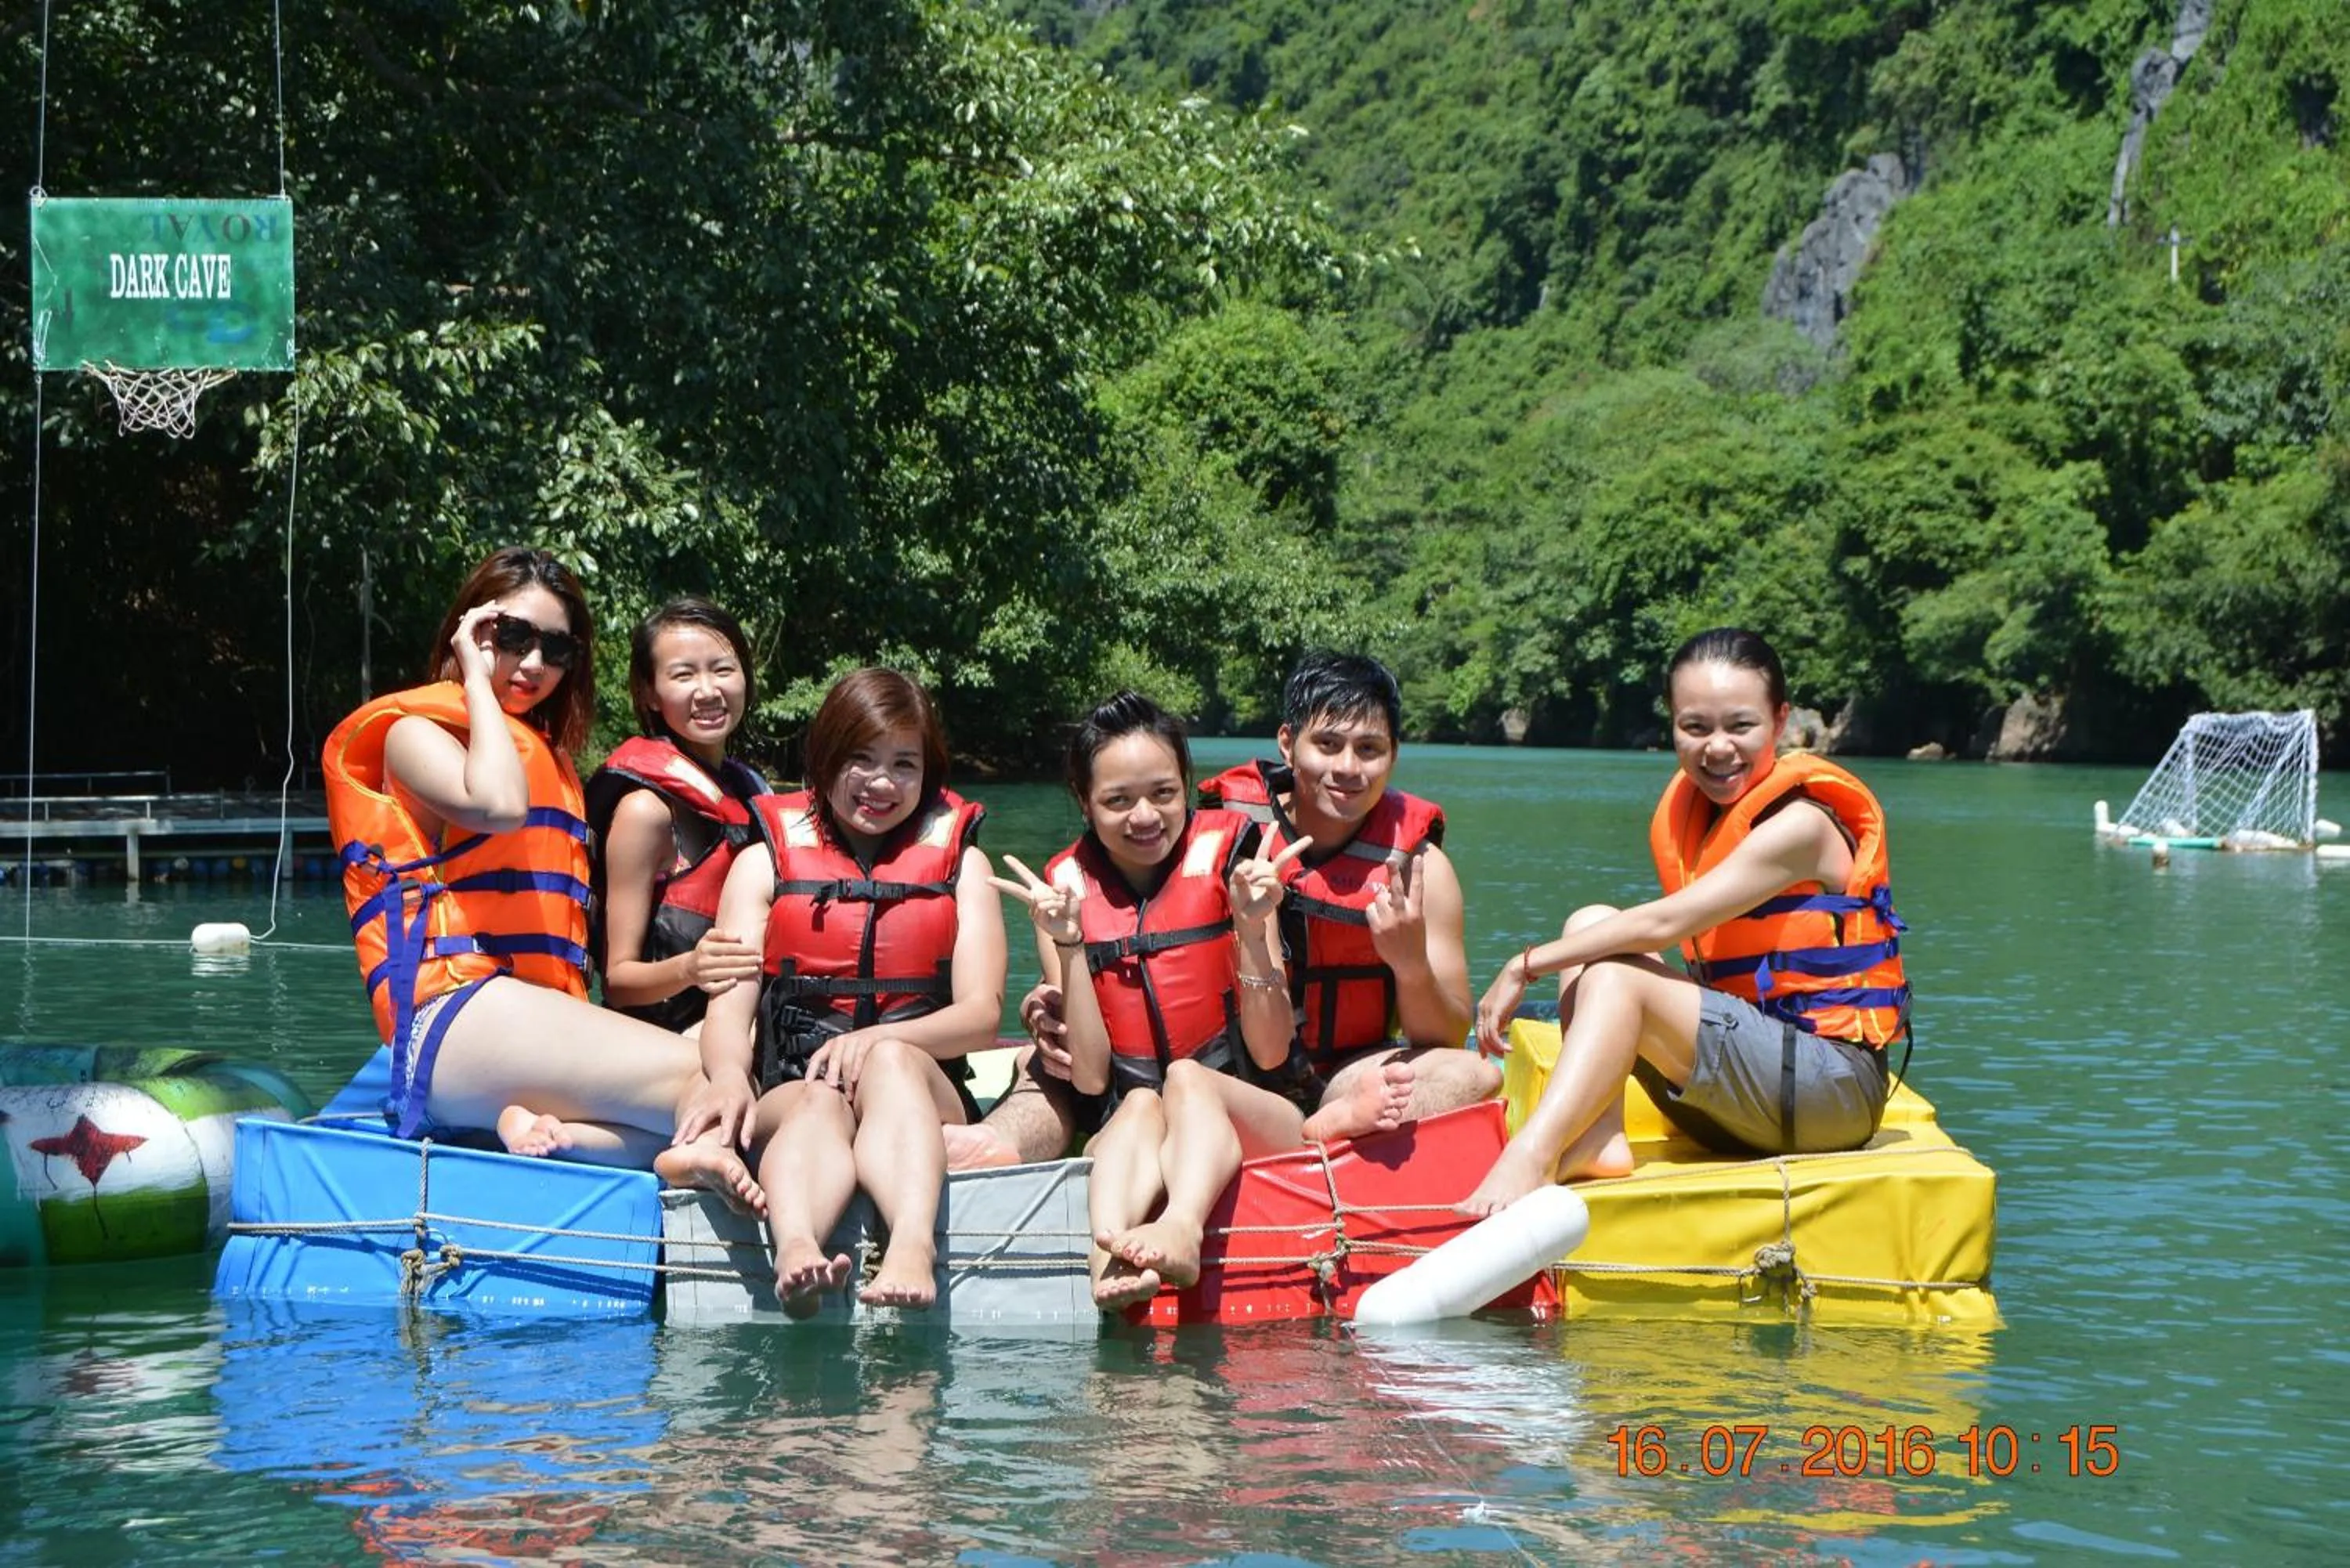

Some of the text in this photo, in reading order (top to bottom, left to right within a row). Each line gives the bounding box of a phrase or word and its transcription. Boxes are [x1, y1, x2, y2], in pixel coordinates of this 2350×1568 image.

[141, 213, 277, 244] ROYAL
[110, 254, 231, 298] DARK CAVE
